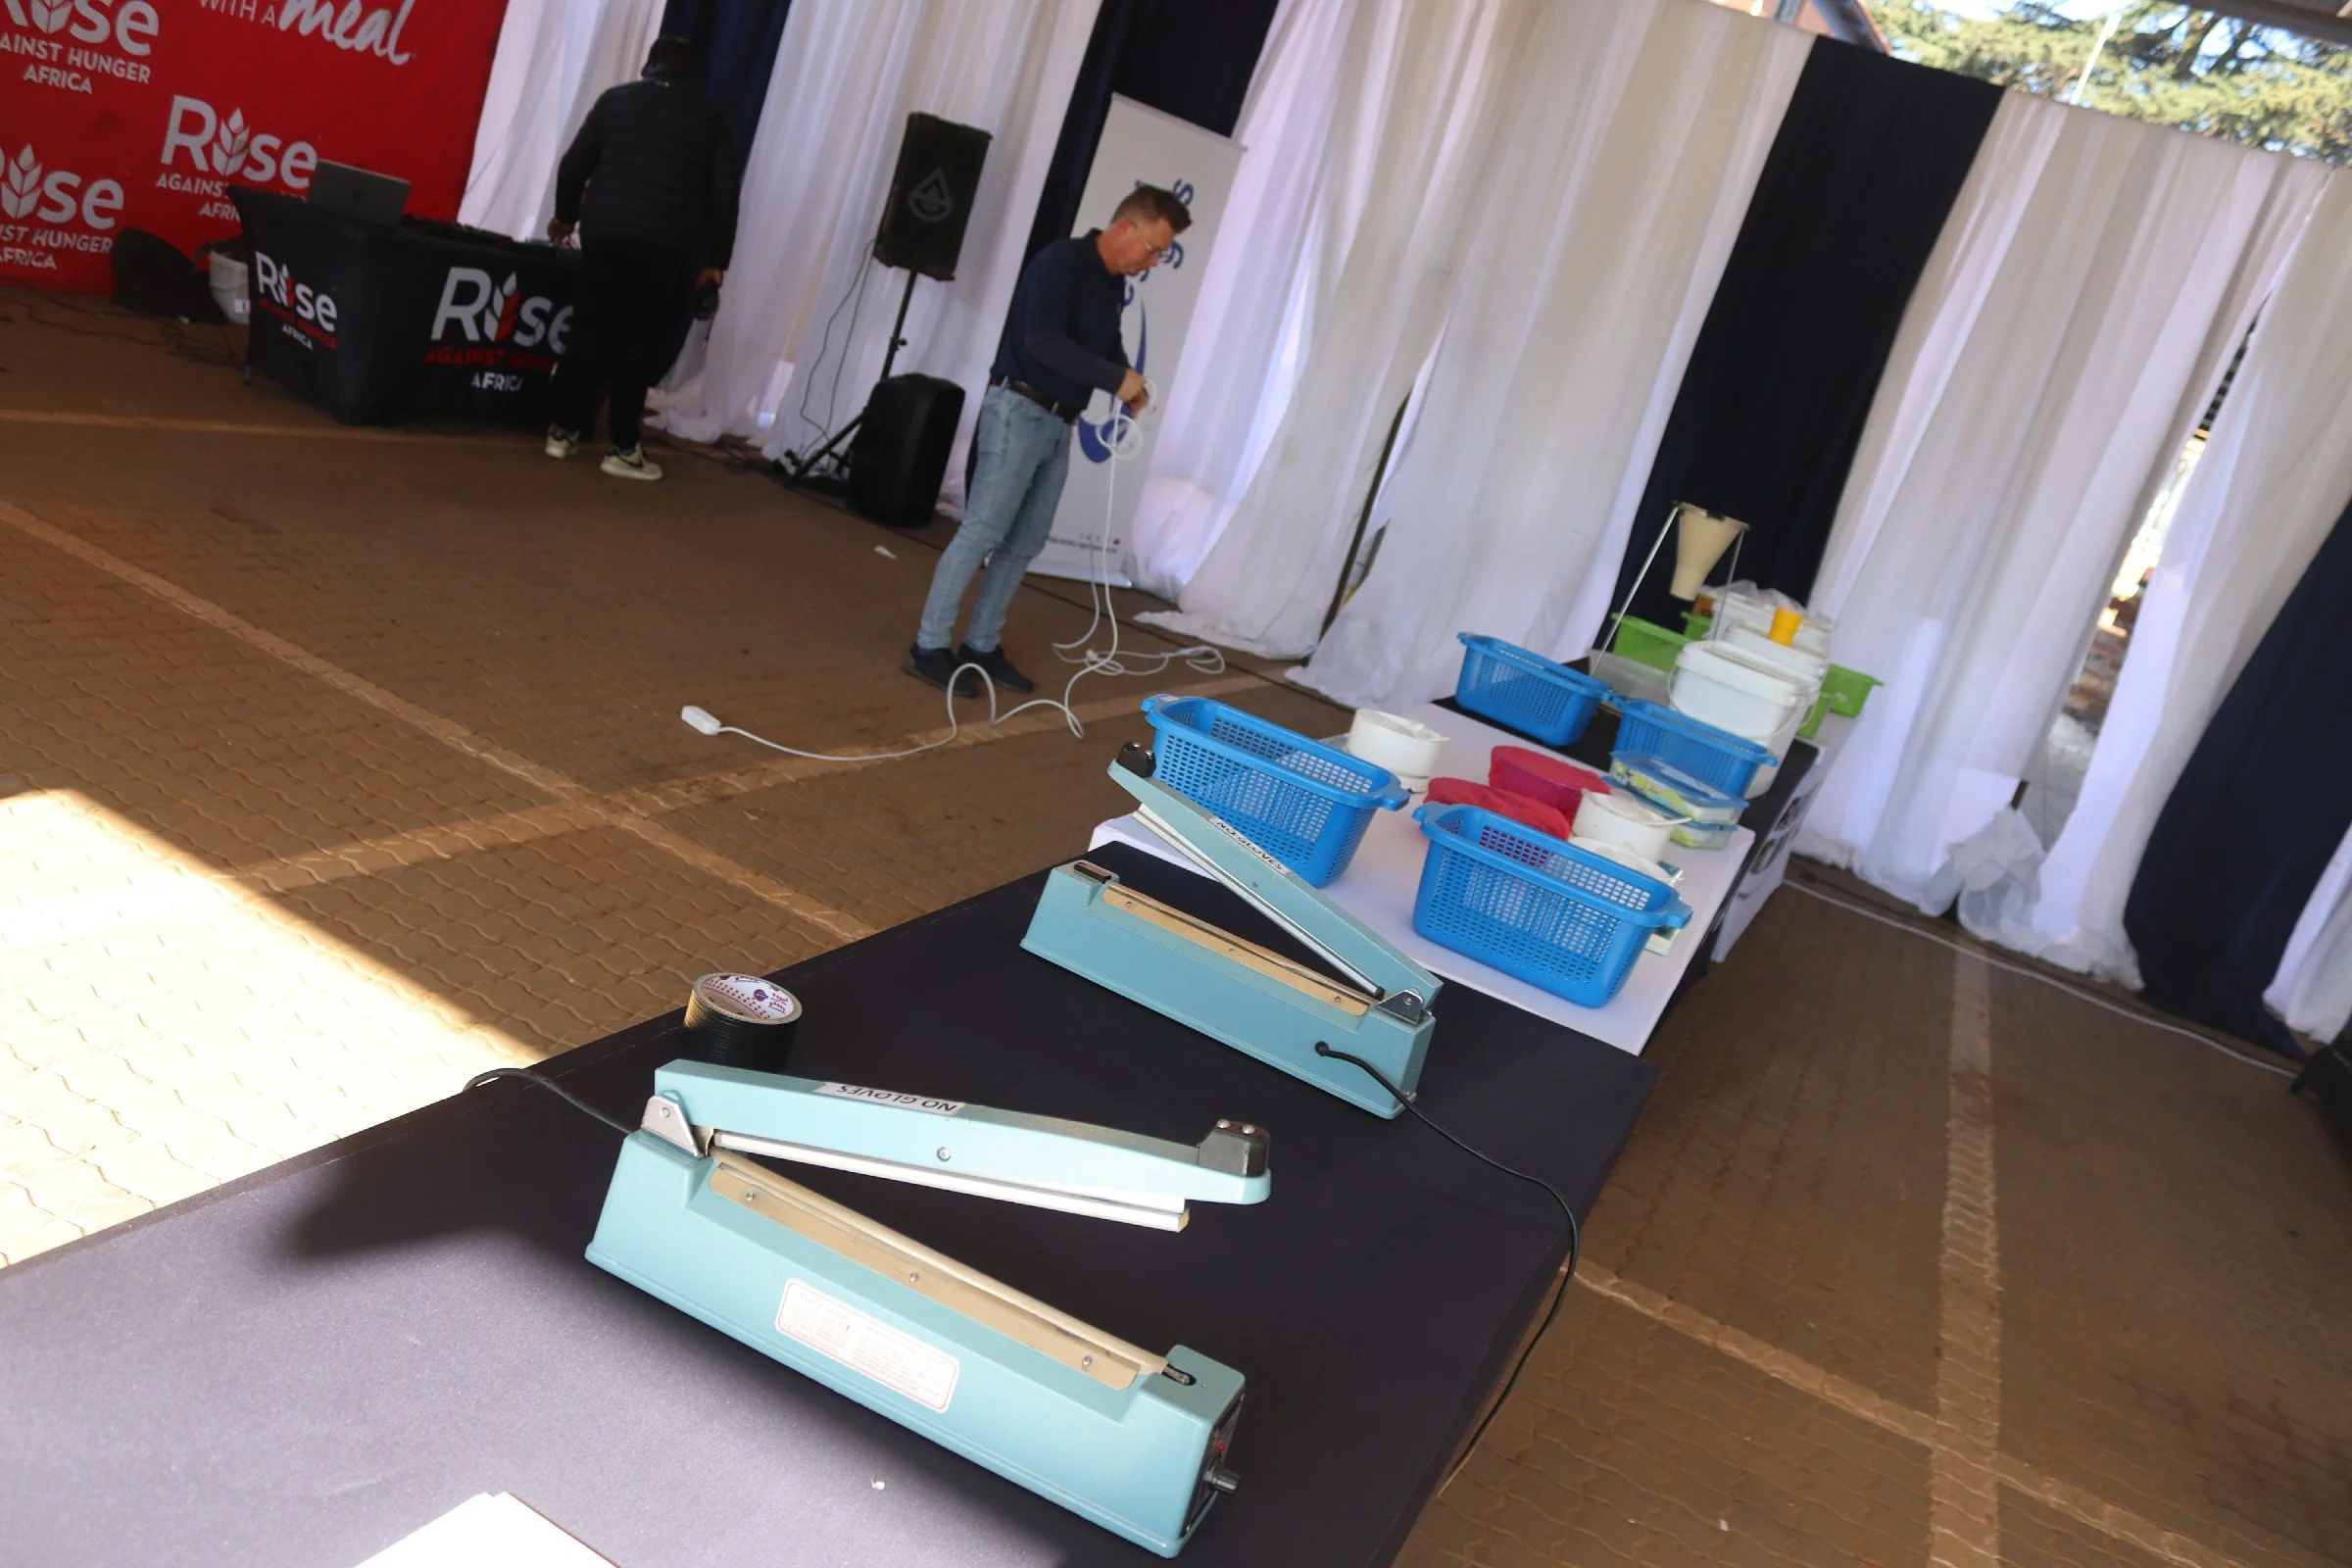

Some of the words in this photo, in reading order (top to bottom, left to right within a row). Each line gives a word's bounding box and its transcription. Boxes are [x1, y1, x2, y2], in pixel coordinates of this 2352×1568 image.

[261, 4, 275, 27] A
[277, 0, 413, 65] meal
[23, 64, 93, 94] AFRICA
[67, 47, 152, 84] HUNGER
[161, 94, 318, 189] Rise
[31, 229, 113, 254] HUNGER
[1216, 821, 1236, 835] NO
[1238, 836, 1282, 870] GLOVES
[836, 1084, 918, 1104] GLOVES
[921, 1100, 957, 1112] NO
